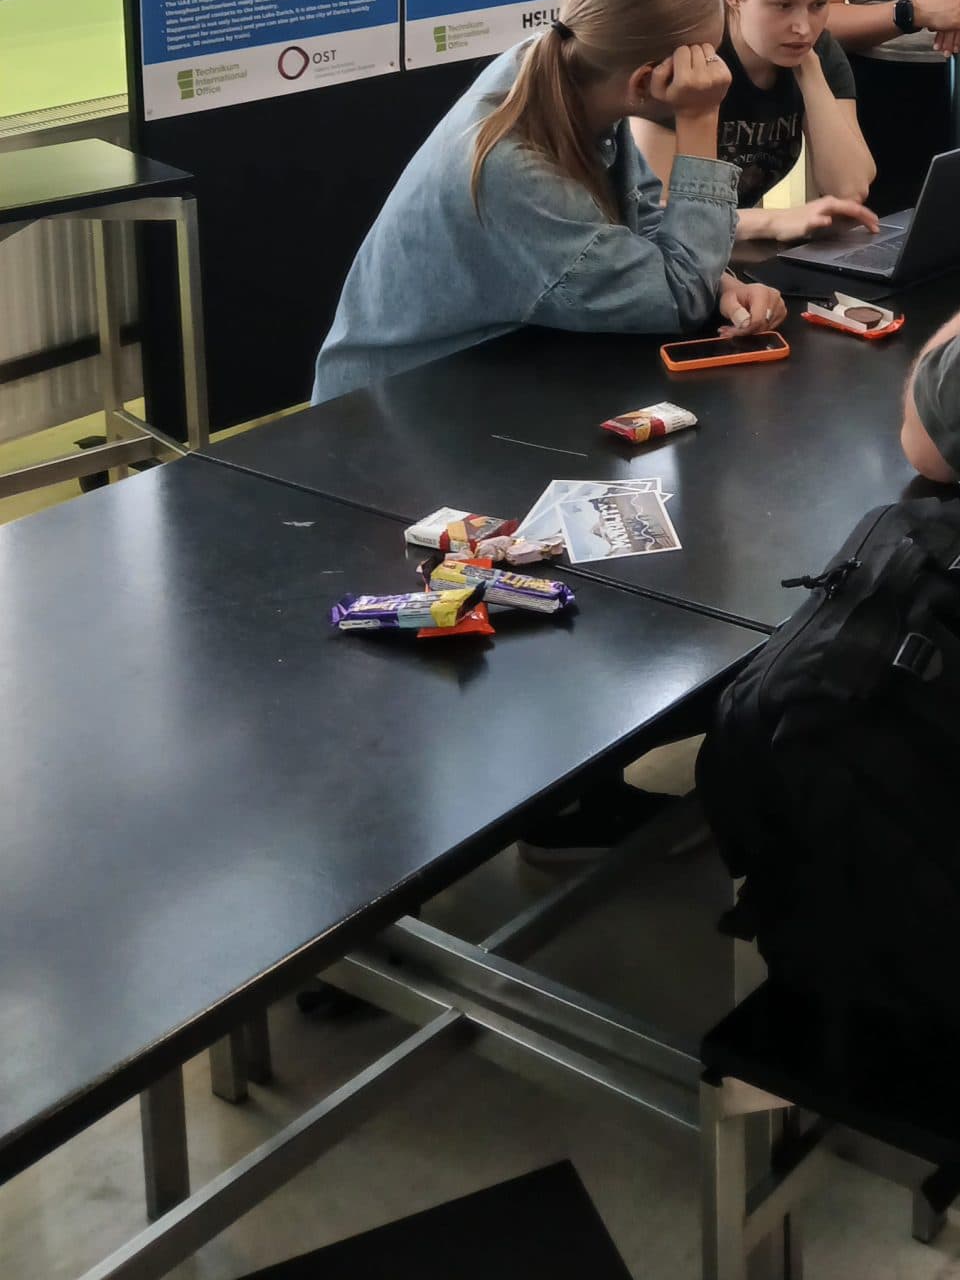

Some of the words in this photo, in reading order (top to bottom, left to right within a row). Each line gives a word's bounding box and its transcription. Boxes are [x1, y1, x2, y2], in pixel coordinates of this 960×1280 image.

[196, 62, 240, 78] Technikum
[312, 49, 337, 64] OST
[196, 72, 248, 86] International
[196, 86, 221, 96] Office
